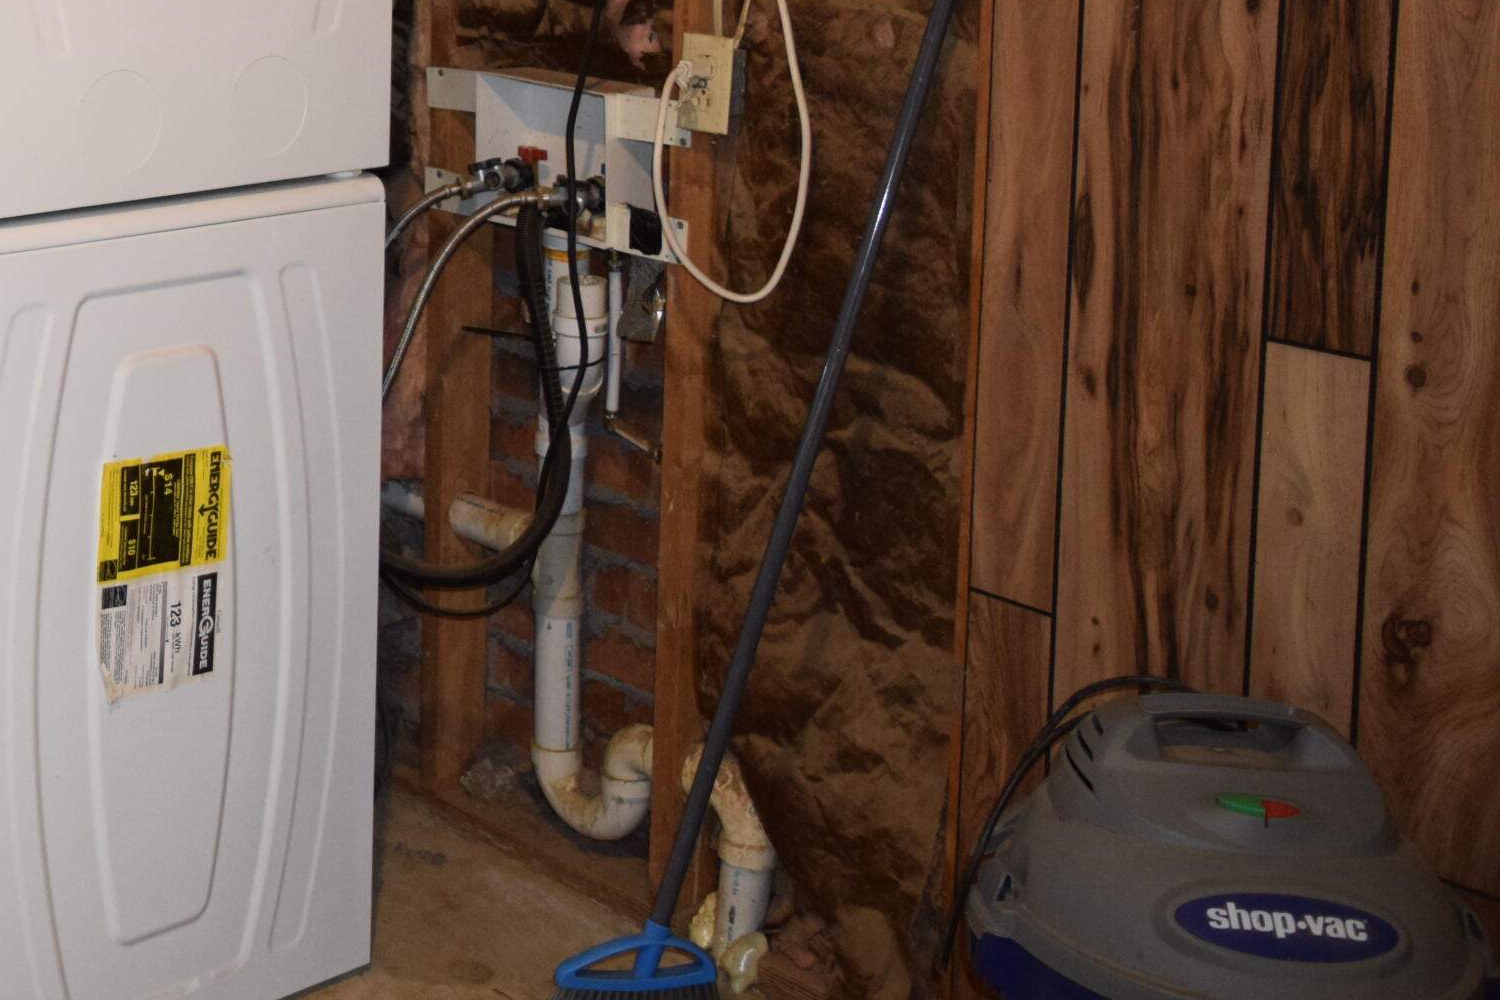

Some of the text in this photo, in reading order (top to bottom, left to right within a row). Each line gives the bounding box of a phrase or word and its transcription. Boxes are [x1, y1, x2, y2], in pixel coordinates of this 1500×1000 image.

[128, 479, 139, 497] 123
[163, 473, 174, 496] $14
[169, 601, 182, 627] 123
[172, 632, 182, 654] kWh
